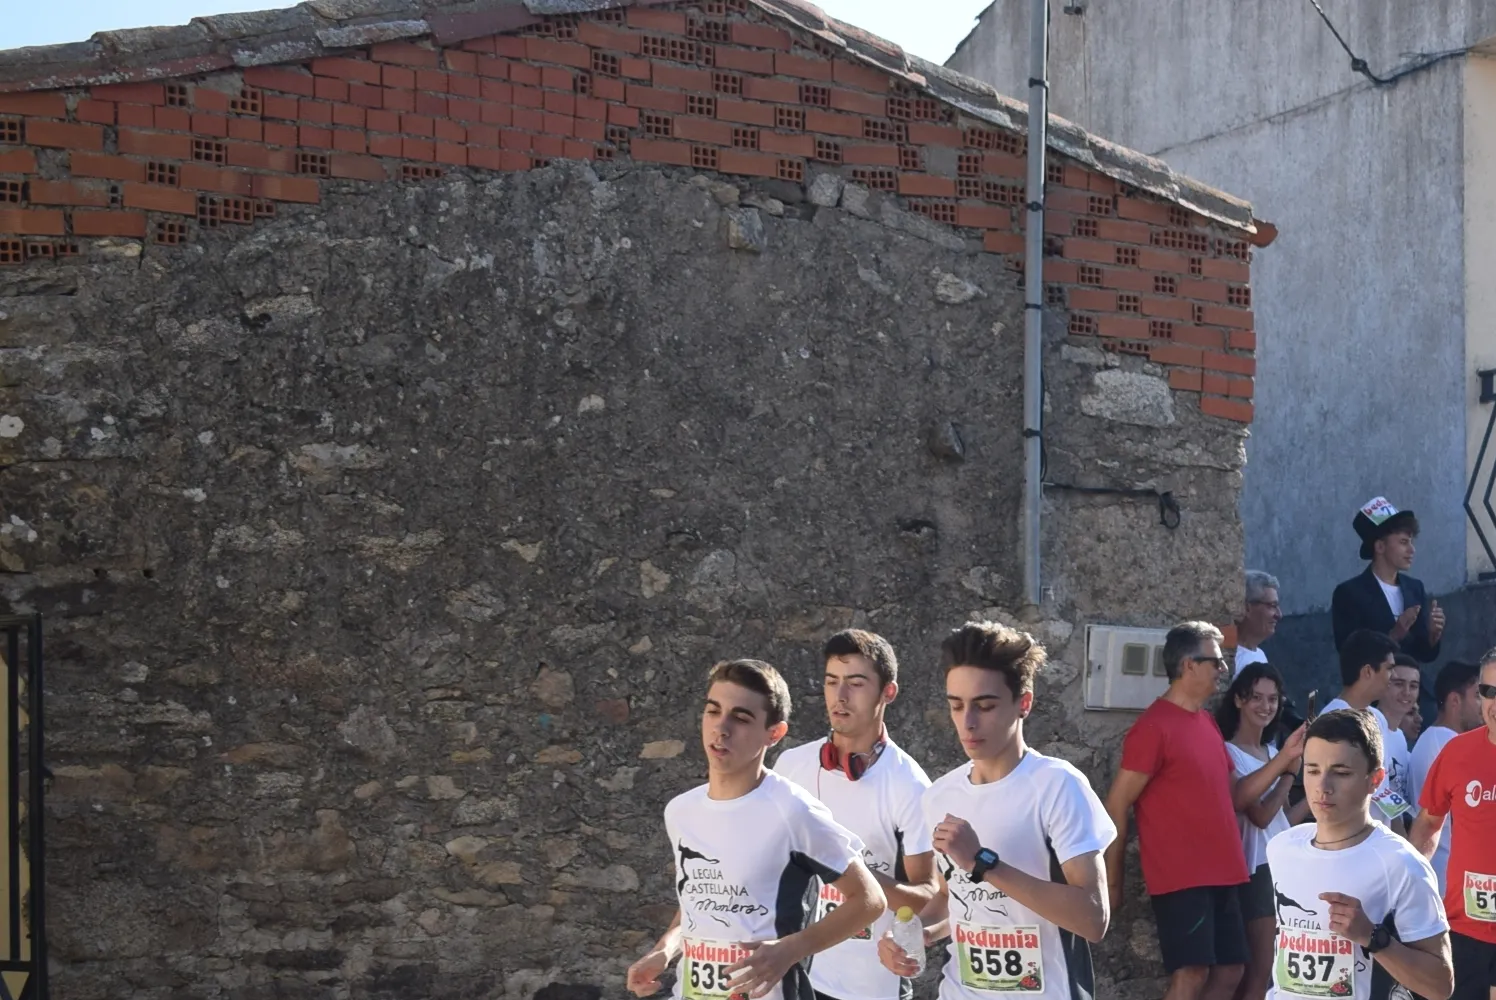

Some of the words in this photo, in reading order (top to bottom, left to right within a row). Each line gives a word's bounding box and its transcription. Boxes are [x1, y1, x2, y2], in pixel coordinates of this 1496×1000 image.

[692, 869, 724, 880] LEGUA
[685, 883, 749, 897] CASTELLANA
[956, 924, 1039, 949] bedunia
[1280, 930, 1353, 955] bedunia
[970, 947, 1023, 977] 558
[1288, 952, 1335, 982] 537
[690, 961, 732, 991] 535
